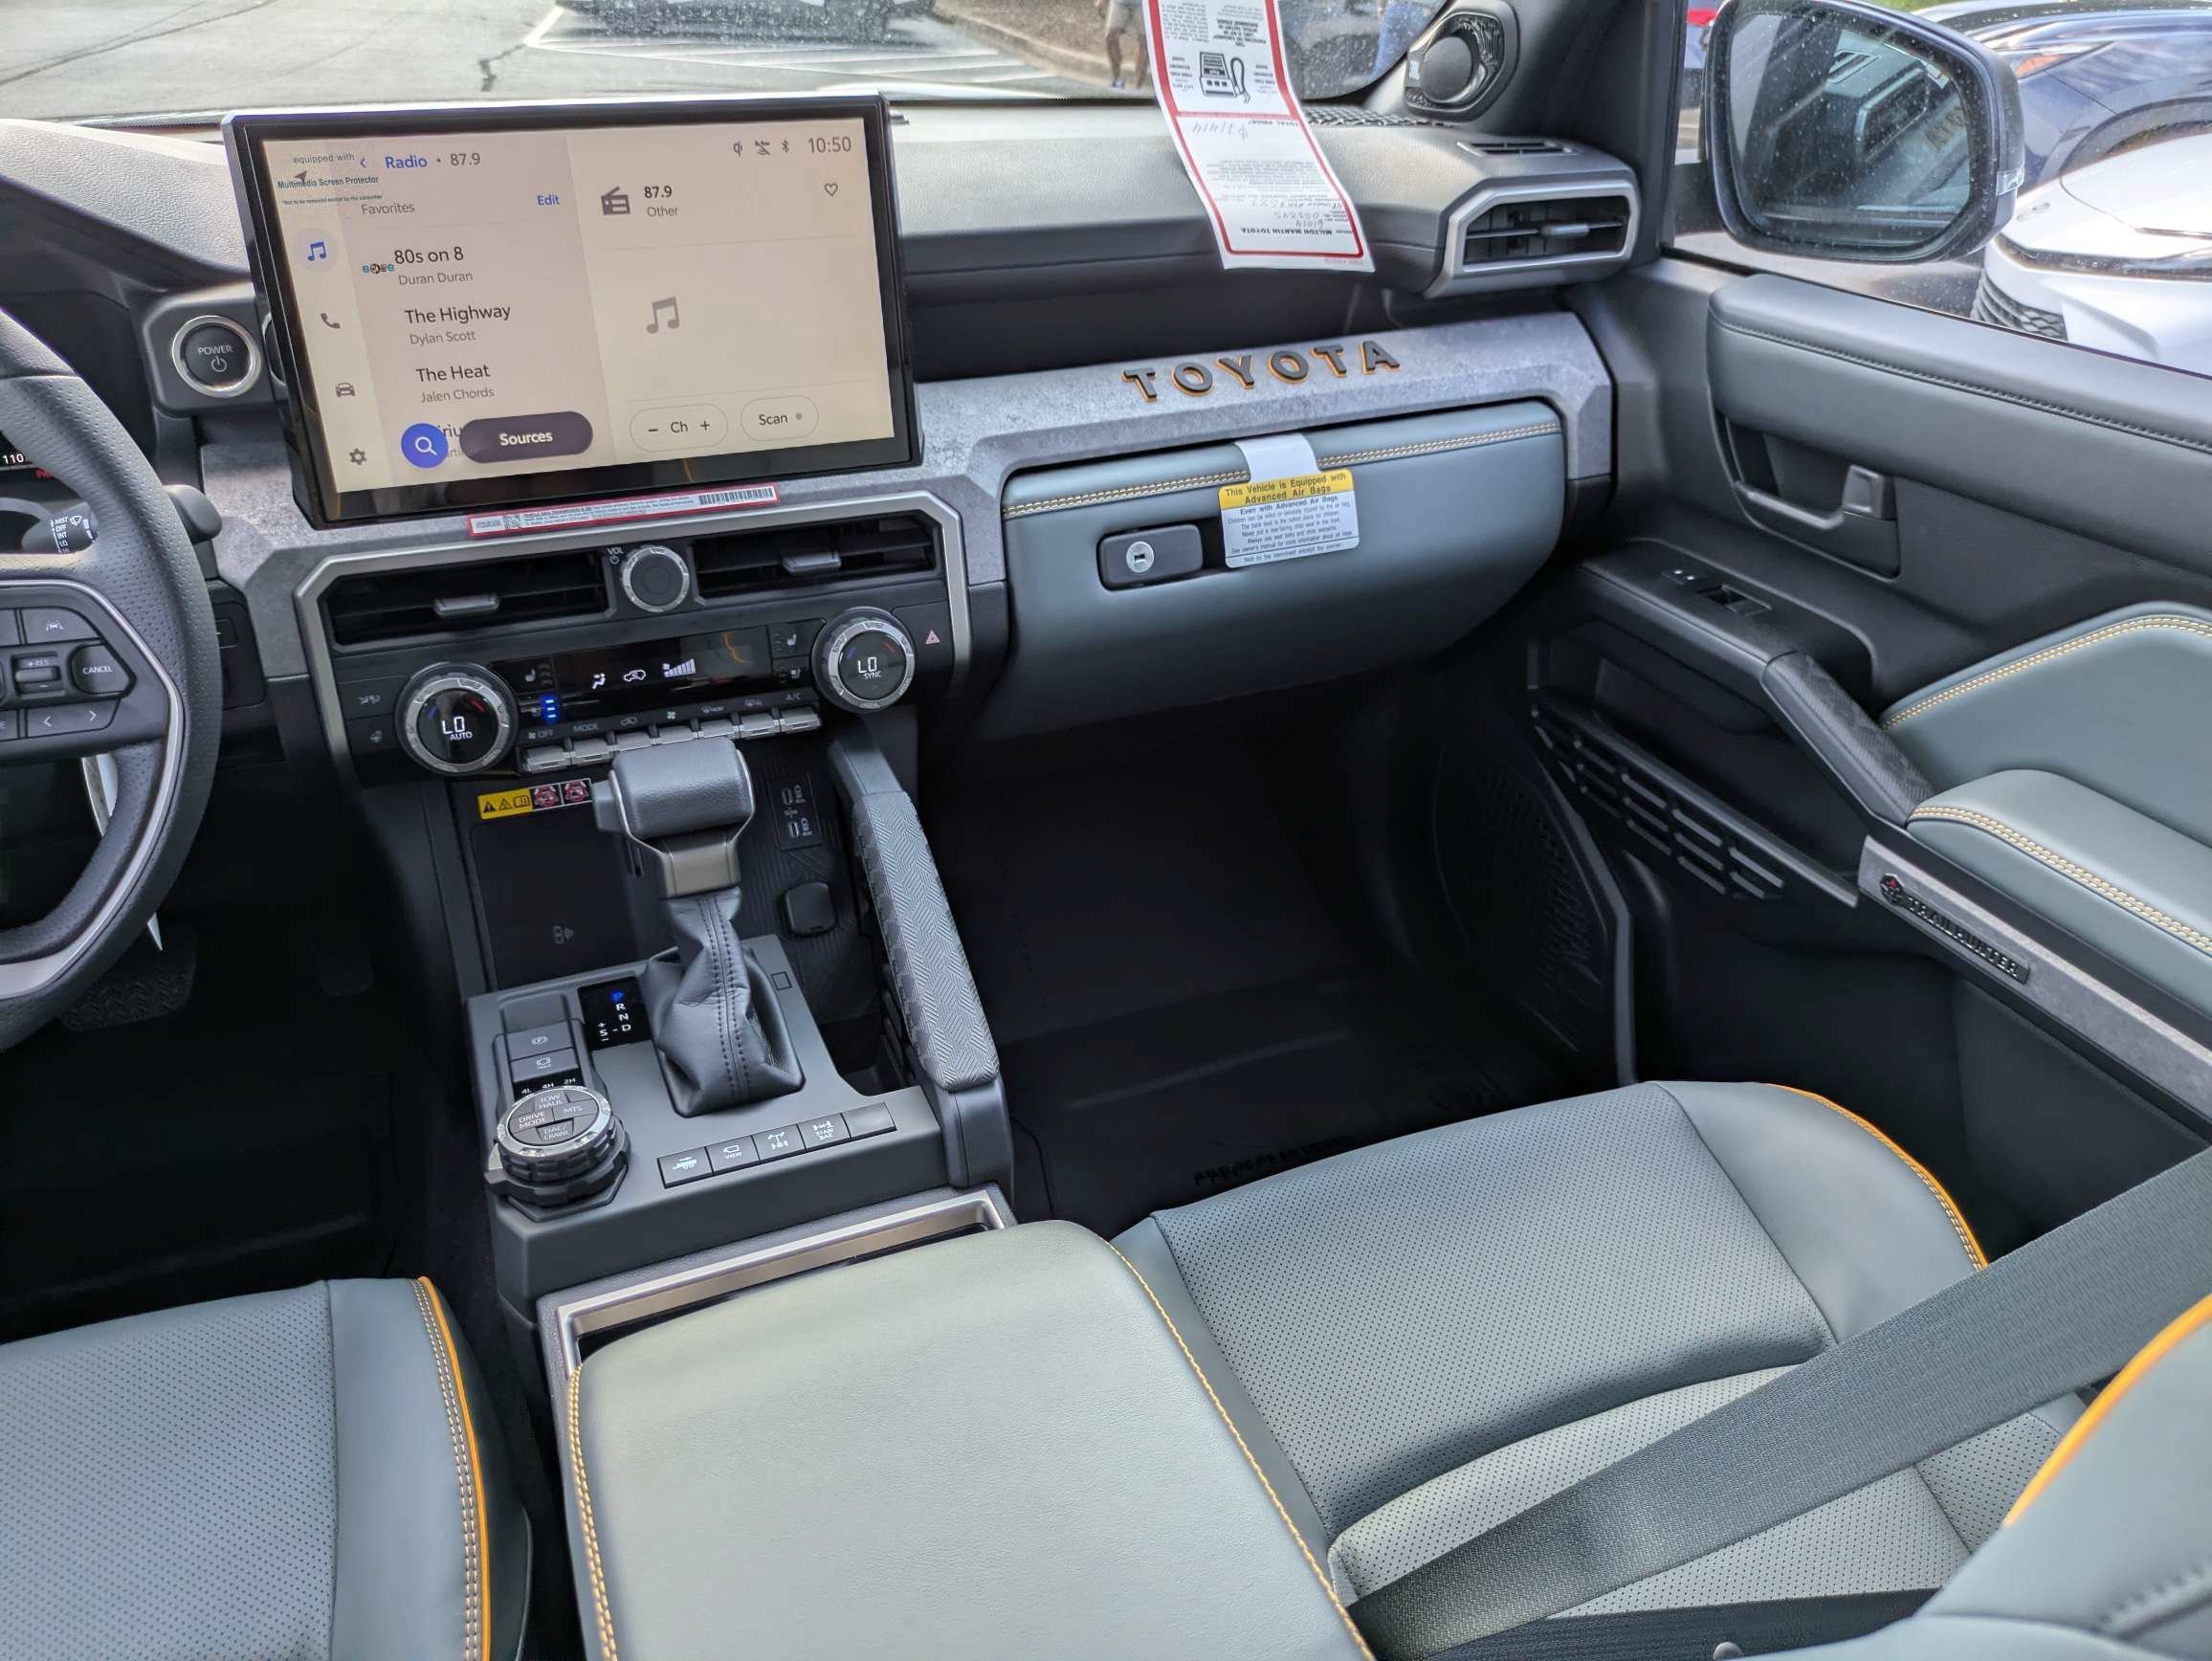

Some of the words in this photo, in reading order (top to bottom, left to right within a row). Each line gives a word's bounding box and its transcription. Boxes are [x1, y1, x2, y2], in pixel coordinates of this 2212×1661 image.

[808, 136, 852, 154] 10:50
[293, 155, 335, 165] equipped
[337, 153, 355, 161] with
[385, 155, 427, 168] Radio
[450, 153, 481, 166] 87.9
[277, 178, 318, 189] Multimedia
[319, 177, 344, 186] Screen
[345, 176, 378, 184] Protector
[644, 186, 673, 199] 87.9
[537, 194, 561, 205] Edit
[361, 203, 415, 215] Favorites
[647, 206, 678, 217] Other
[394, 249, 423, 265] 80s
[428, 250, 449, 262] on
[453, 246, 464, 261] 8
[398, 275, 435, 285] Duran
[437, 272, 473, 283] Duran
[404, 308, 436, 324] The
[440, 305, 511, 324] Highway
[409, 333, 443, 346] Dylan
[446, 331, 476, 342] Scott
[198, 344, 234, 355] POWER
[416, 367, 447, 383] The
[450, 364, 490, 380] Heat
[1122, 340, 1401, 403] TOYOTA
[421, 391, 451, 404] Jalen
[453, 387, 494, 400] Chords
[759, 413, 788, 426] Scan
[670, 421, 688, 433] Ch
[499, 432, 553, 446] Sources
[2, 454, 24, 465] 110
[1226, 488, 1242, 497] This
[1247, 483, 1275, 494] Vehicle
[1290, 475, 1326, 488] Equipped
[1330, 472, 1345, 481] with
[1245, 491, 1287, 504] Advanced
[1292, 488, 1305, 497] Air
[1310, 484, 1332, 495] Bags
[1276, 500, 1306, 509] Advanced
[82, 666, 113, 674] CANCEL
[858, 657, 877, 673] LO
[864, 671, 882, 679] SYNC
[786, 692, 802, 701] A/C
[442, 716, 465, 735] LO
[574, 723, 598, 732] MODE
[450, 731, 474, 740] AUTO
[538, 730, 554, 739] OFF
[612, 992, 624, 1002] P
[615, 1003, 626, 1011] R
[618, 1013, 630, 1021] N
[539, 1100, 563, 1109] HAUL
[519, 1111, 544, 1123] DRIVE
[519, 1118, 546, 1129] MODE
[544, 1130, 570, 1140] CRAWL
